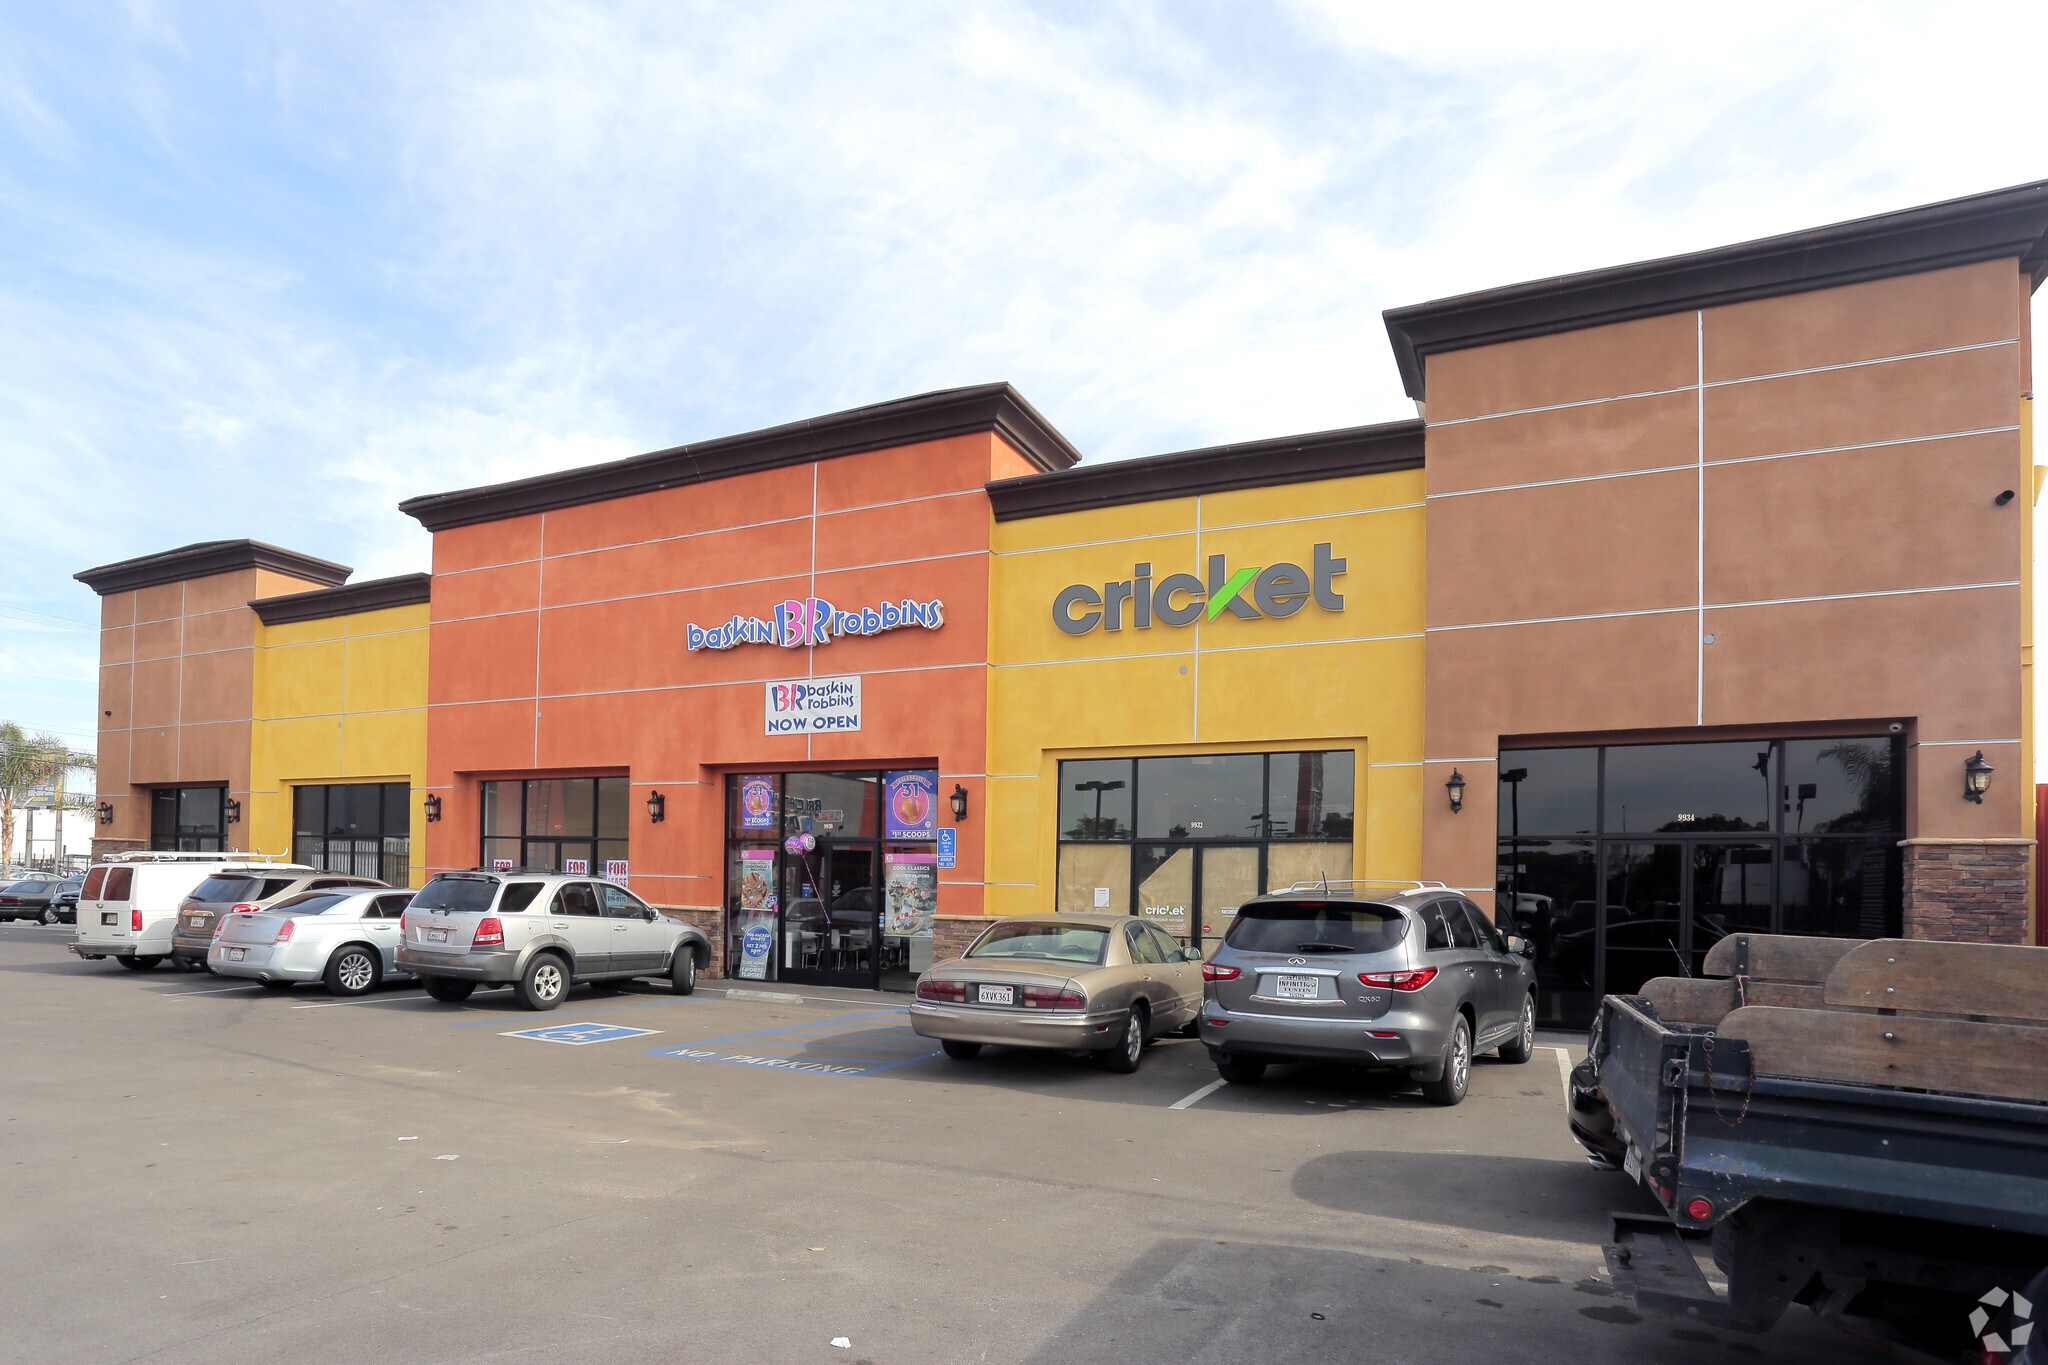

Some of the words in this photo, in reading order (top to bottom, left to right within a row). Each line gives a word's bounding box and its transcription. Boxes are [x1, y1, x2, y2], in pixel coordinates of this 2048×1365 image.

[1053, 543, 1347, 635] cricket
[687, 616, 776, 651] baskin
[774, 598, 832, 647] BR
[834, 599, 943, 635] robbins
[807, 681, 853, 697] baskin
[771, 684, 806, 712] BR
[808, 695, 854, 710] robbins
[768, 718, 808, 732] NOW
[813, 715, 858, 729] OPEN
[901, 782, 919, 798] 31
[1678, 813, 1695, 821] 9934
[1190, 821, 1204, 829] 9932
[568, 862, 586, 874] FOR
[608, 862, 627, 875] FOR
[1145, 905, 1185, 916] cricket
[980, 992, 1011, 1002] 6XVK361
[668, 1049, 716, 1058] NO
[720, 1054, 866, 1075] PARKING
